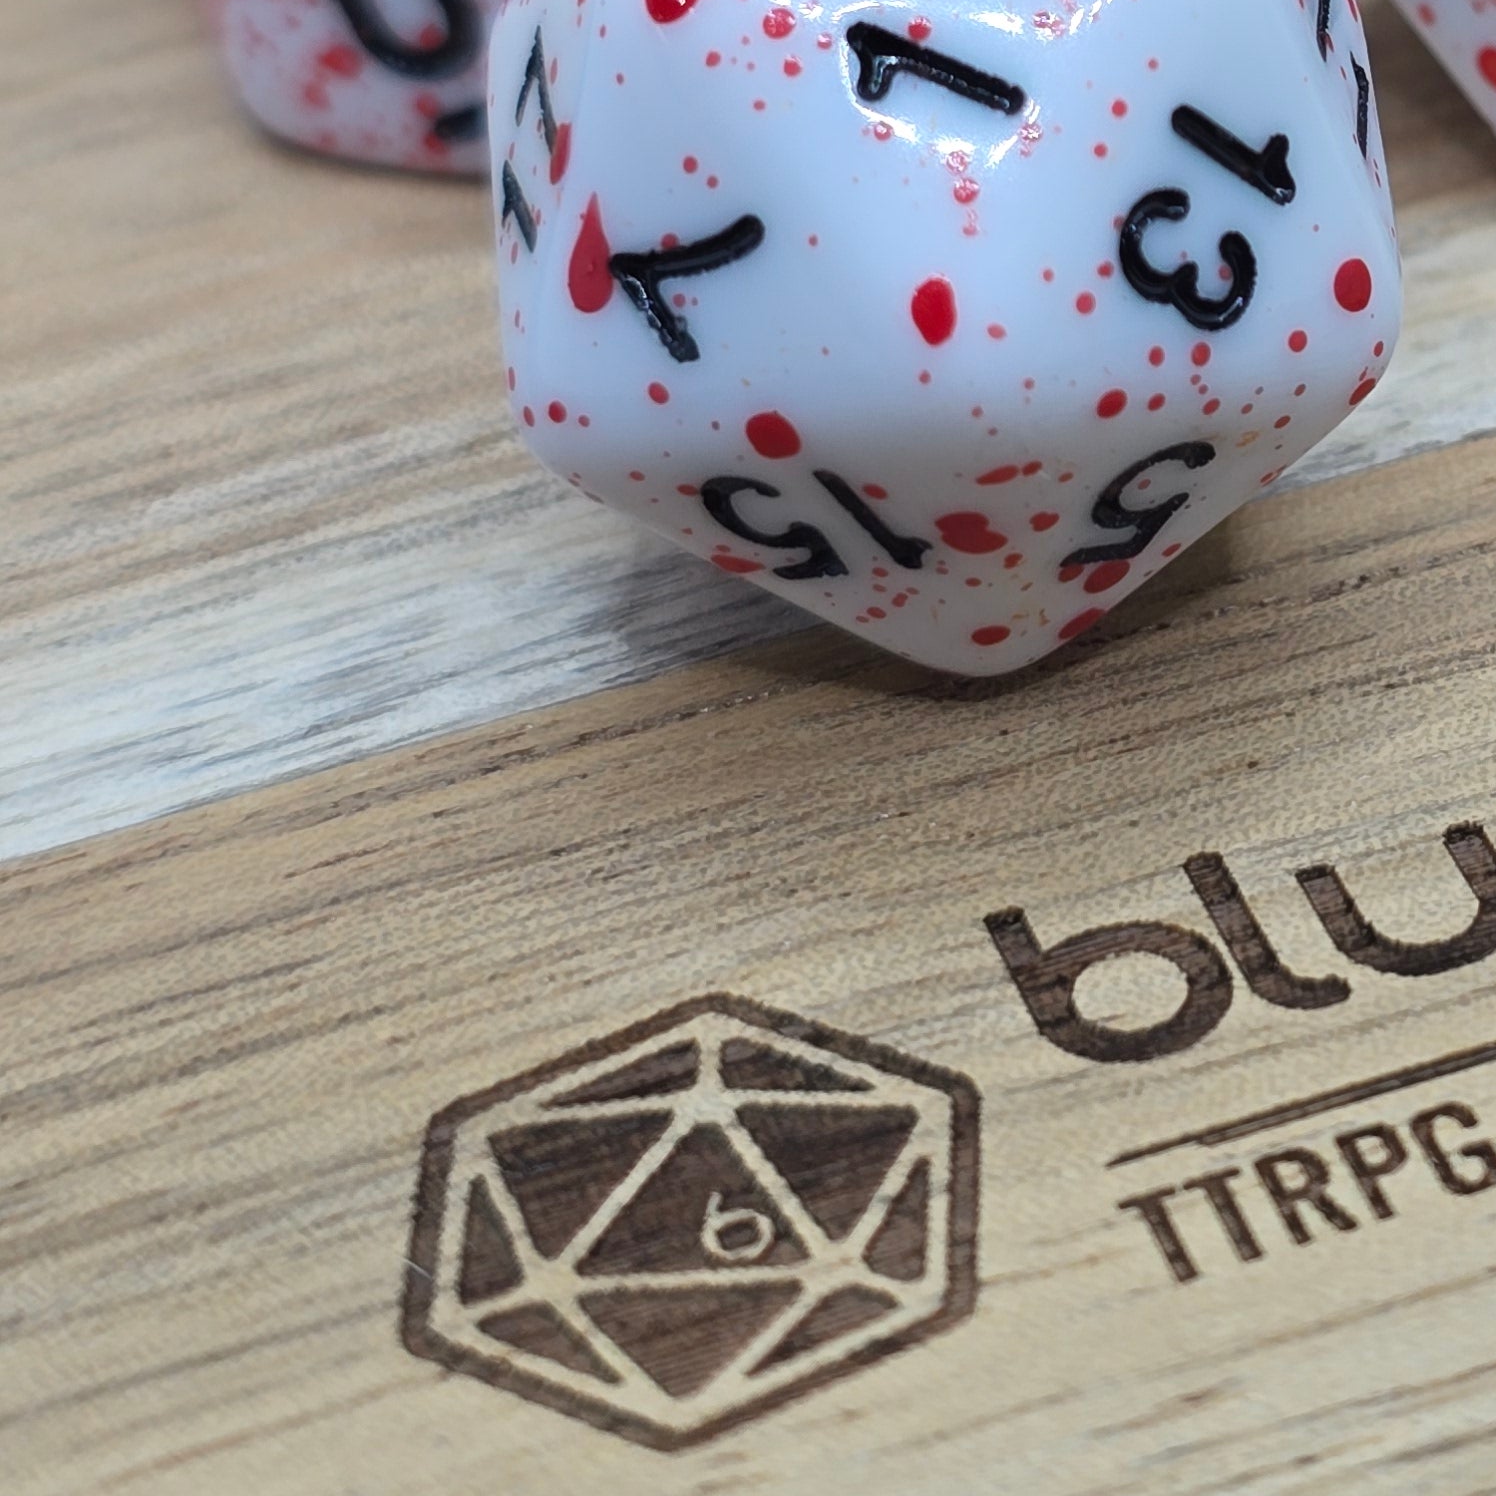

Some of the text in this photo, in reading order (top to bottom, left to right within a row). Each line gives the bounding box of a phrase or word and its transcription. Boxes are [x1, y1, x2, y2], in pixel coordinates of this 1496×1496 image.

[846, 21, 1027, 116] 1
[1118, 104, 1296, 332] 13
[609, 214, 765, 362] 7
[700, 470, 933, 581] 15
[1058, 441, 1217, 570] 5
